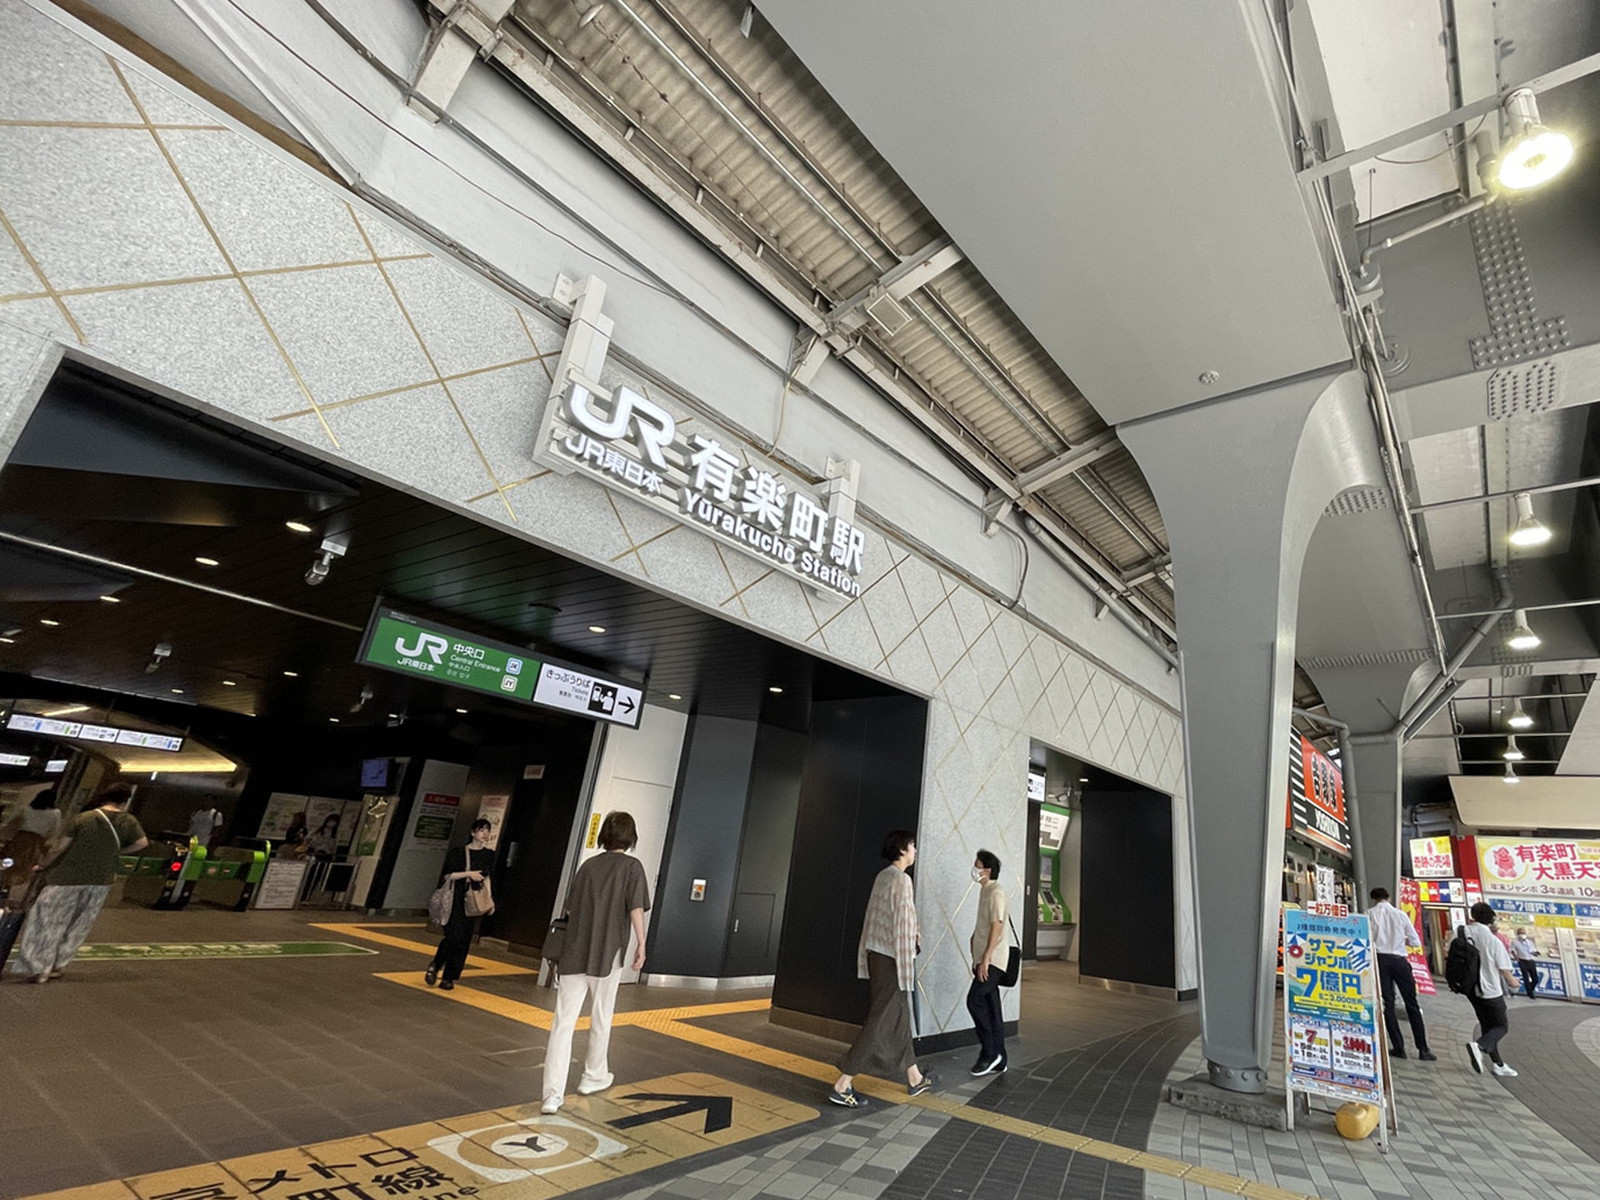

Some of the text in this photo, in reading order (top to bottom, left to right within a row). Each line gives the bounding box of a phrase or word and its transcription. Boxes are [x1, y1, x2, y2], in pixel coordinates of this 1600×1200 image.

[568, 383, 675, 471] JR
[565, 434, 663, 495] JR東日本
[689, 433, 865, 574] 有楽町駅
[686, 487, 861, 598] Yūrakuchō Station
[395, 633, 448, 664] JR
[453, 643, 485, 660] 中央口
[450, 654, 501, 673] Central Entrance
[546, 669, 592, 690] きっぷうりば
[1514, 843, 1577, 862] 有楽町
[1308, 938, 1349, 954] サマー
[1304, 953, 1353, 970] ジャンボ
[1296, 967, 1362, 998] 7億円
[501, 1136, 547, 1153] Y
